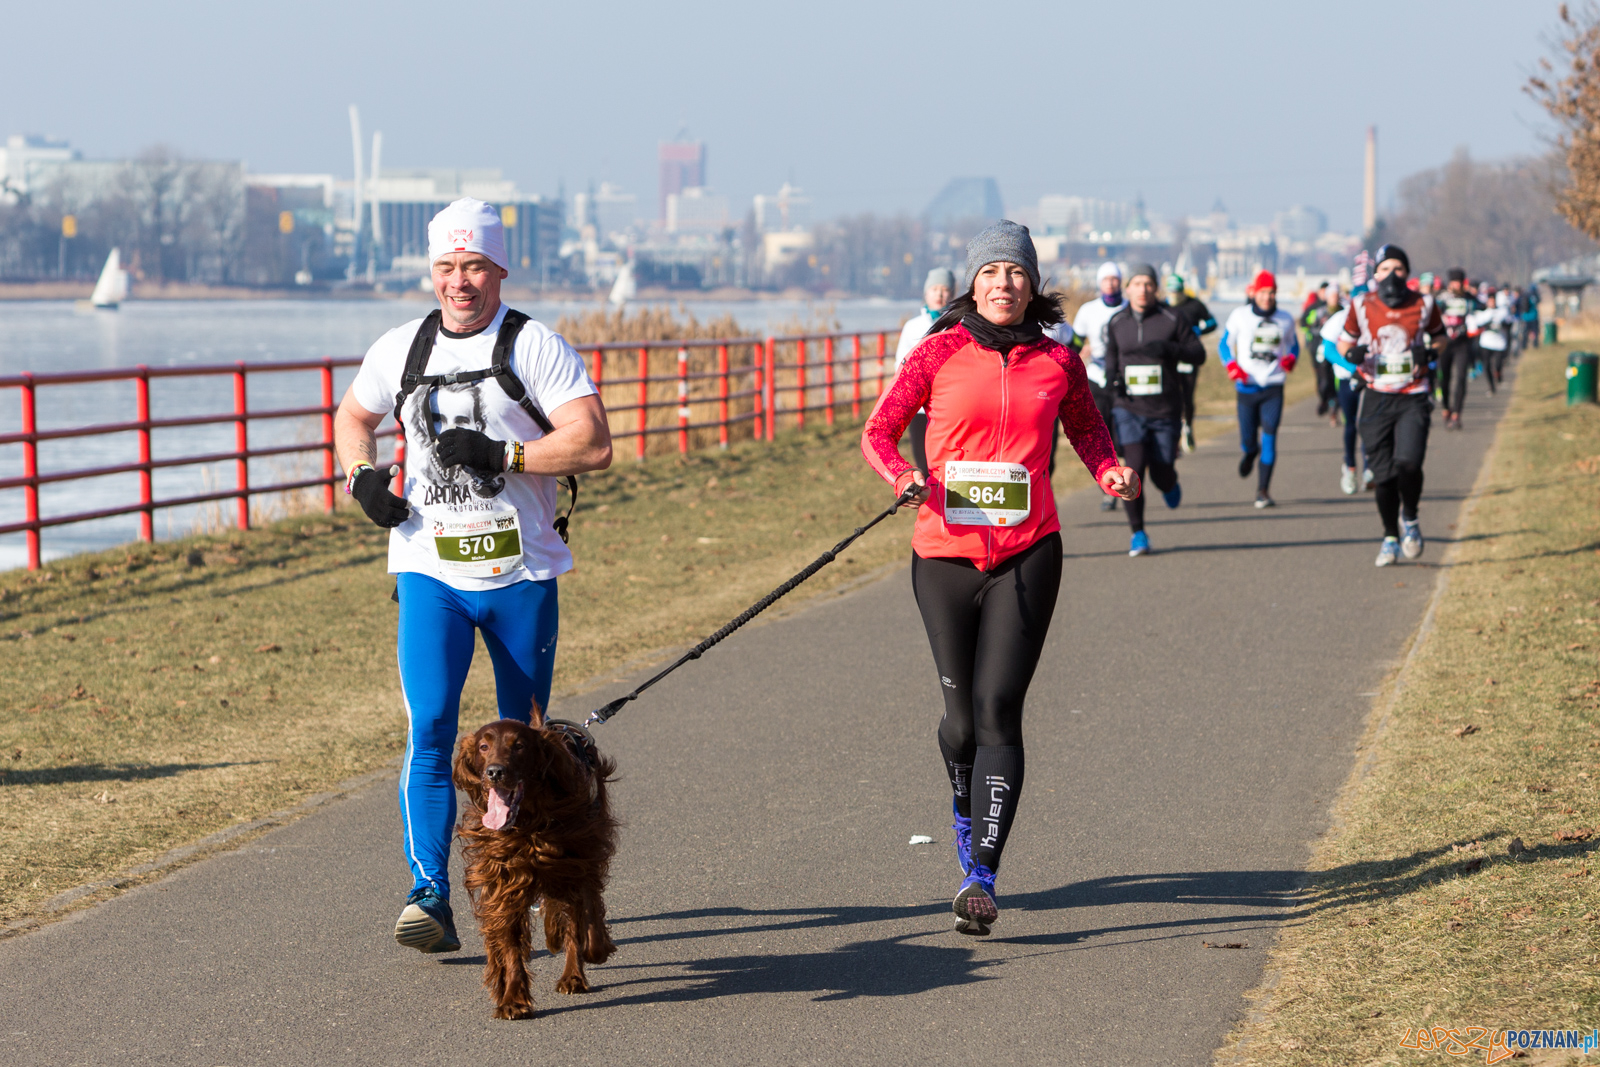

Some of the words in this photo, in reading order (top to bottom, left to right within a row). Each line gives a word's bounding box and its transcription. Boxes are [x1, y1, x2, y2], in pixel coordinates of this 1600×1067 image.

[969, 486, 1006, 505] 964
[447, 503, 494, 513] EKUTOWSKI
[459, 535, 495, 555] 570
[980, 775, 1011, 849] kalenji
